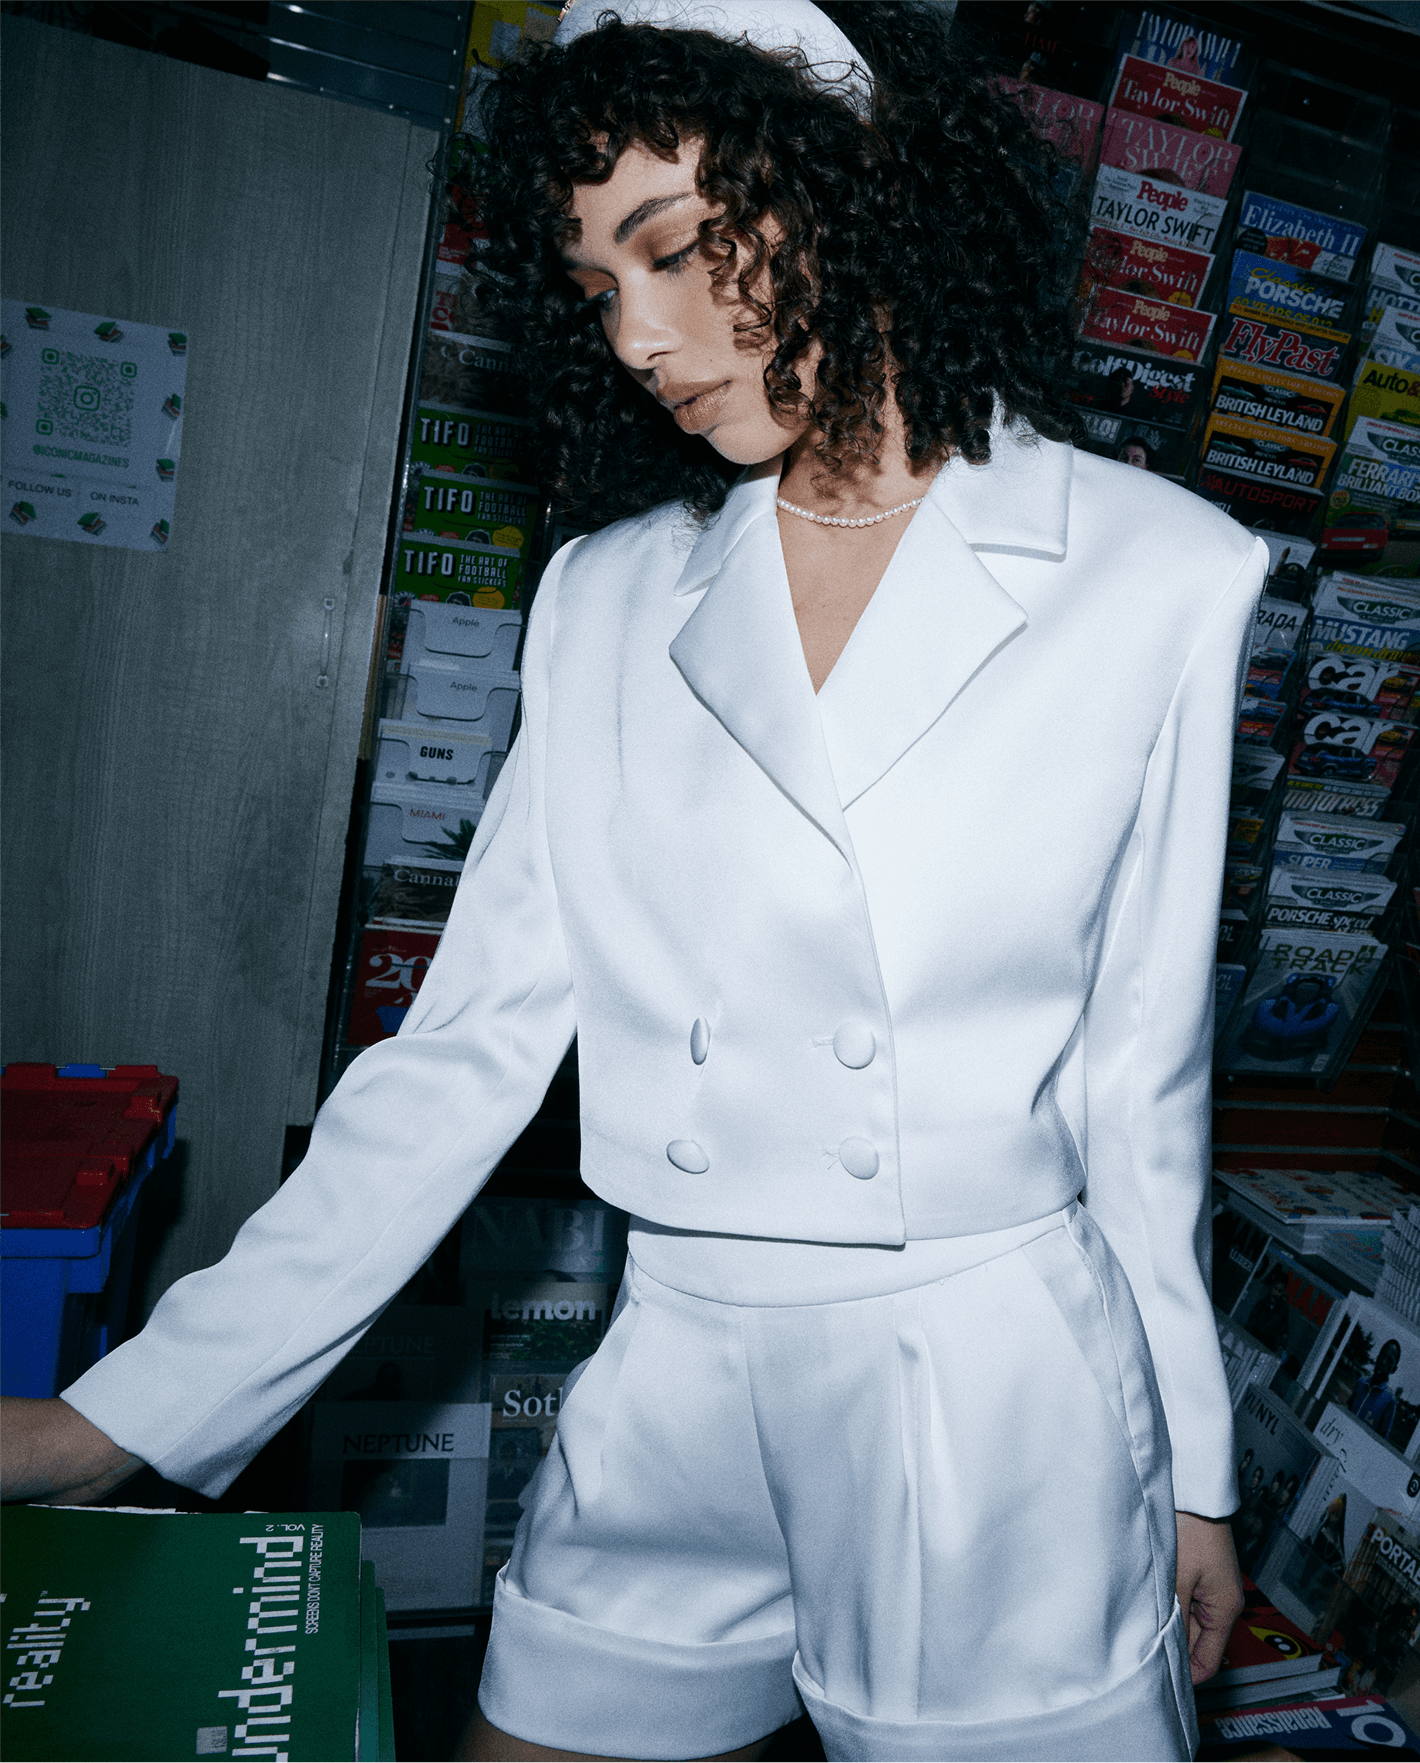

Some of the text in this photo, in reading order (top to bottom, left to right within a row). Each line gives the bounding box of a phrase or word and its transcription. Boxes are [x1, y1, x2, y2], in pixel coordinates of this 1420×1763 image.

[1162, 71, 1202, 97] People
[1121, 77, 1232, 130] Taylor Swift
[1121, 118, 1233, 173] TAYLOR
[1136, 180, 1189, 212] People
[1096, 196, 1160, 231] TAYLOR
[1161, 216, 1215, 246] SWIFT
[1243, 203, 1336, 250] Elizabeth
[1340, 233, 1361, 256] II
[1129, 239, 1169, 263] People
[1149, 263, 1198, 292] Swift
[1132, 299, 1171, 322] People
[1244, 275, 1346, 319] PORSCHE
[1150, 322, 1200, 351] Swift
[1224, 316, 1341, 377] FlyPast
[1215, 394, 1324, 432] BRITISH LEYLAND
[420, 417, 471, 447] TIFO
[32, 444, 130, 468] @ICONICMAGAZINES
[1206, 448, 1315, 485] BRITISH LEYLAND
[8, 479, 140, 506] FOLLOW US ON INSTA
[424, 485, 475, 513] TIFO
[480, 491, 497, 501] THE
[499, 493, 516, 504] ART
[1210, 476, 1320, 512] AUTOSPORT
[1336, 473, 1396, 498] BRILLIANT
[477, 513, 492, 521] FAN
[478, 501, 528, 517] FOOTBALL
[404, 549, 455, 576] TIFO
[458, 564, 508, 580] FOOTBALL
[460, 554, 509, 568] THE ART OF
[457, 575, 508, 588] FAN STICKERS
[452, 616, 480, 628] Apple
[1353, 600, 1412, 620] CLASSIC
[1311, 618, 1411, 651] MUSTANG
[450, 681, 478, 692] Apple
[1303, 712, 1396, 755] car
[420, 746, 454, 761] GUNS
[409, 808, 446, 821] MIAMI
[1309, 832, 1367, 851] CLASSIC
[1306, 886, 1364, 904] CLASSIC
[1267, 906, 1335, 926] PORSCHE
[1271, 956, 1365, 976] TRACK
[1273, 944, 1356, 963] ROAD
[491, 1291, 596, 1321] lemon
[343, 1433, 455, 1454] NEPTUNE
[1320, 1418, 1344, 1446] dry
[265, 1523, 274, 1532] 2
[310, 1523, 324, 1552] REALITY
[308, 1551, 322, 1582] CAPTURE
[304, 1602, 320, 1634] SCREENS
[1214, 1706, 1333, 1740] Renaissance
